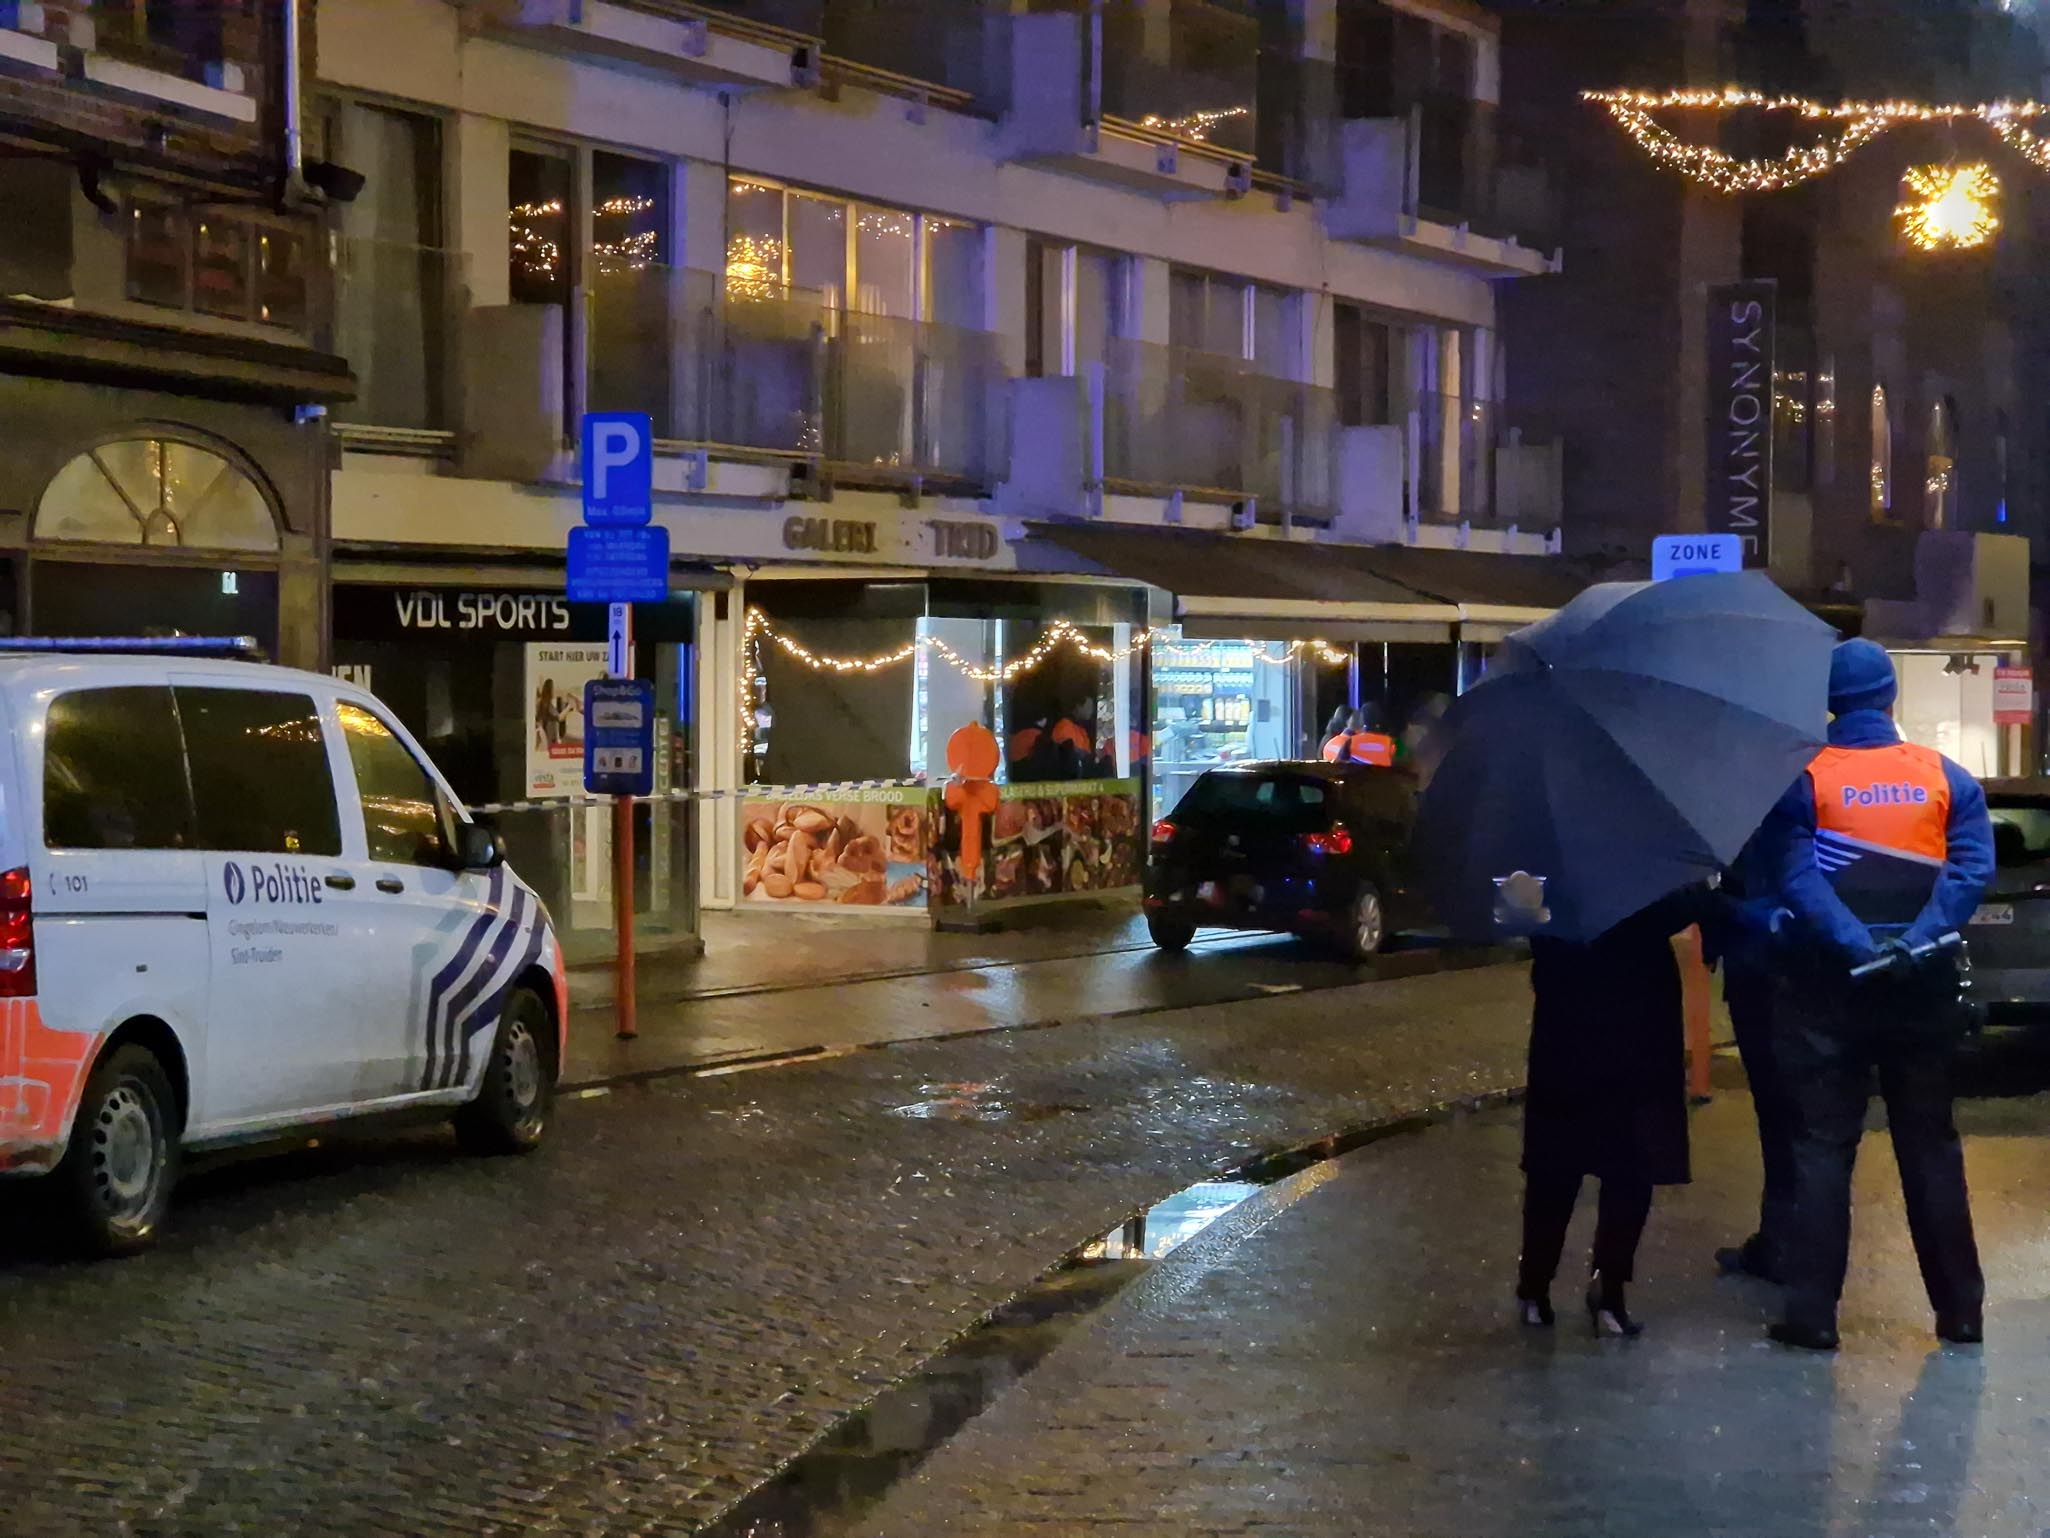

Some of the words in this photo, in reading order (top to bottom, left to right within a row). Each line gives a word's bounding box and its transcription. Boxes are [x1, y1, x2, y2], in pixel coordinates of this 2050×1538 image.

[592, 421, 640, 500] P
[1670, 544, 1722, 560] ZONE
[394, 591, 452, 628] VDL
[457, 592, 571, 630] SPORTS
[538, 650, 564, 662] START
[566, 650, 584, 662] HIER
[586, 650, 600, 662] UW
[826, 788, 857, 801] VERSE
[863, 790, 903, 802] BROOD
[1842, 781, 1927, 807] Politie
[65, 874, 88, 892] 101
[251, 863, 323, 903] Politie
